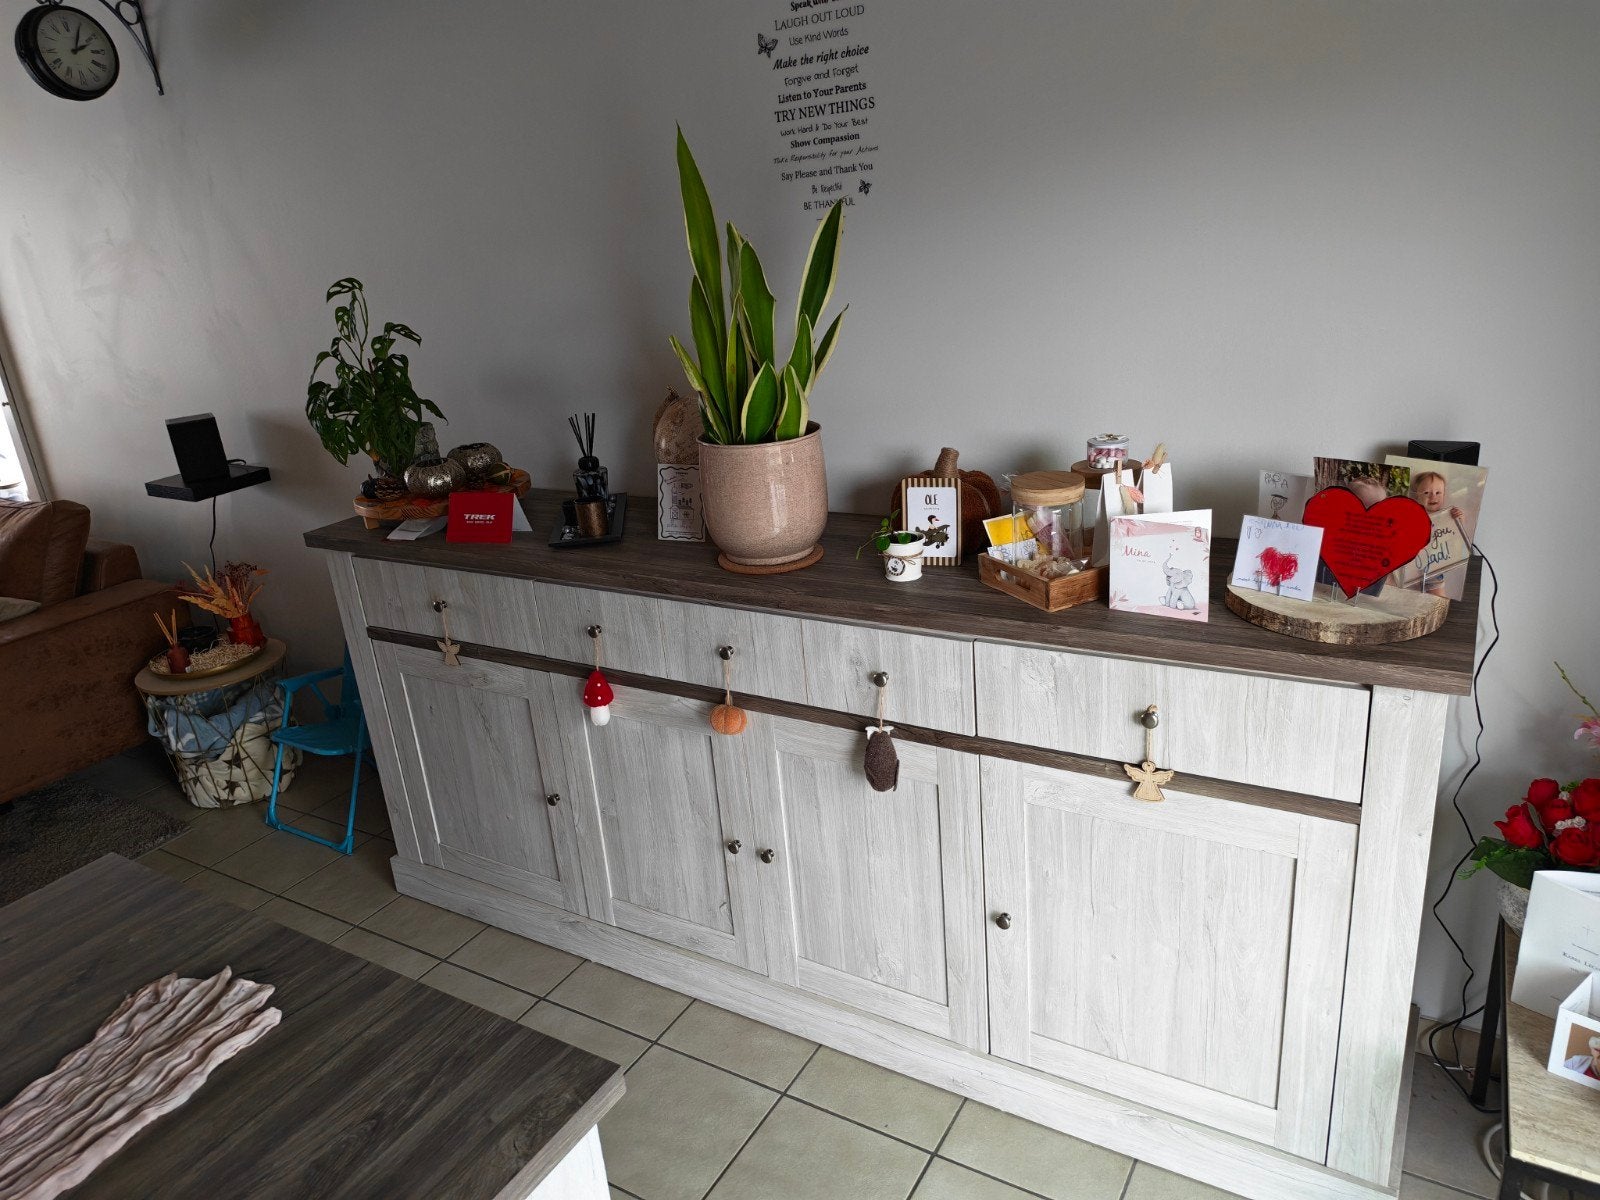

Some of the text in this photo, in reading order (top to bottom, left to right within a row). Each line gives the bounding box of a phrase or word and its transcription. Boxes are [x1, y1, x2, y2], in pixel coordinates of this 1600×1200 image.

[774, 5, 865, 31] LAUGH OUT LOUD
[788, 27, 849, 46] Use Kind Words
[773, 45, 870, 71] Make the right choice
[814, 70, 831, 80] and
[832, 64, 859, 78] Forget
[778, 81, 867, 104] Listen to Your Parents
[774, 97, 875, 123] TRY NEW THINGS
[822, 122, 832, 131] Do
[833, 120, 848, 129] Your
[851, 117, 869, 127] Best
[790, 132, 860, 149] Show Compassion
[781, 162, 874, 181] Say Please and Thank You
[803, 201, 813, 211] BE
[924, 493, 939, 505] OLE
[1122, 545, 1151, 558] Mina
